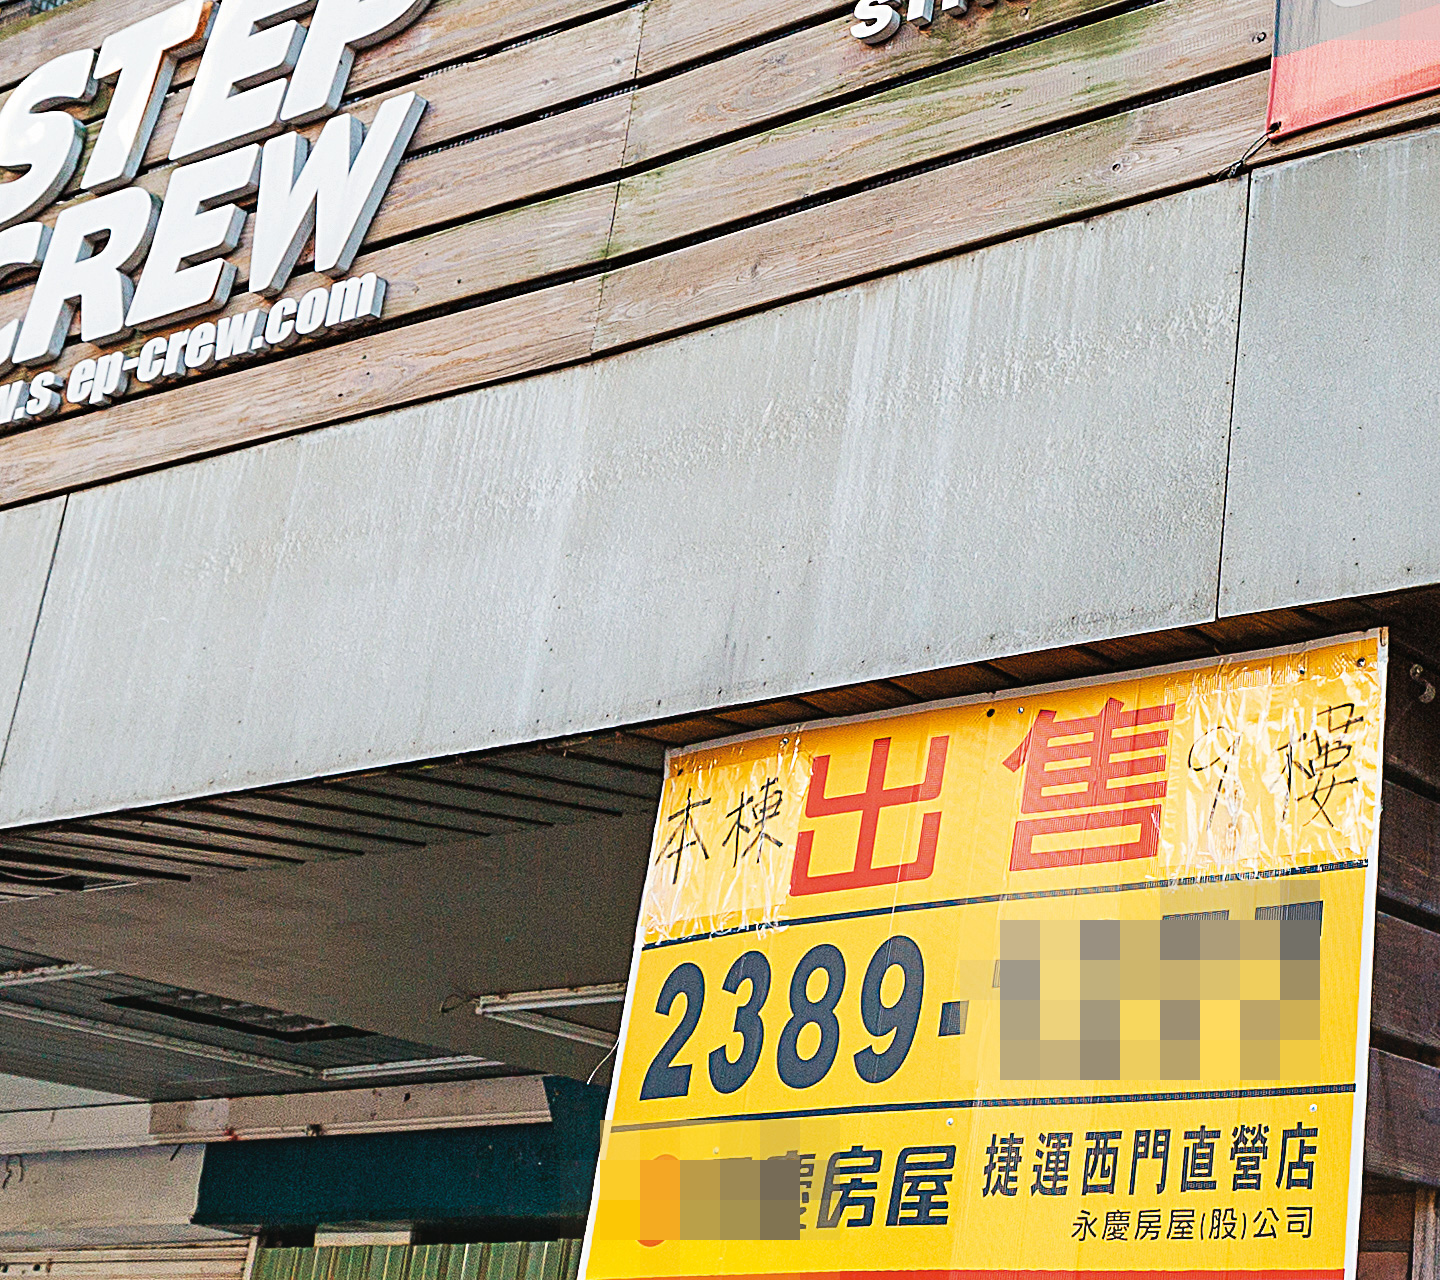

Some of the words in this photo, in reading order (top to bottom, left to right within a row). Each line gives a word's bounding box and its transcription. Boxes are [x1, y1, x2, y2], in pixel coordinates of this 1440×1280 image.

[656, 775, 790, 890] 本棟
[789, 696, 1177, 898] 出售
[982, 1121, 1318, 1200] 捷運西門直營店
[1070, 1204, 1316, 1245] 永慶房屋(股)公司
